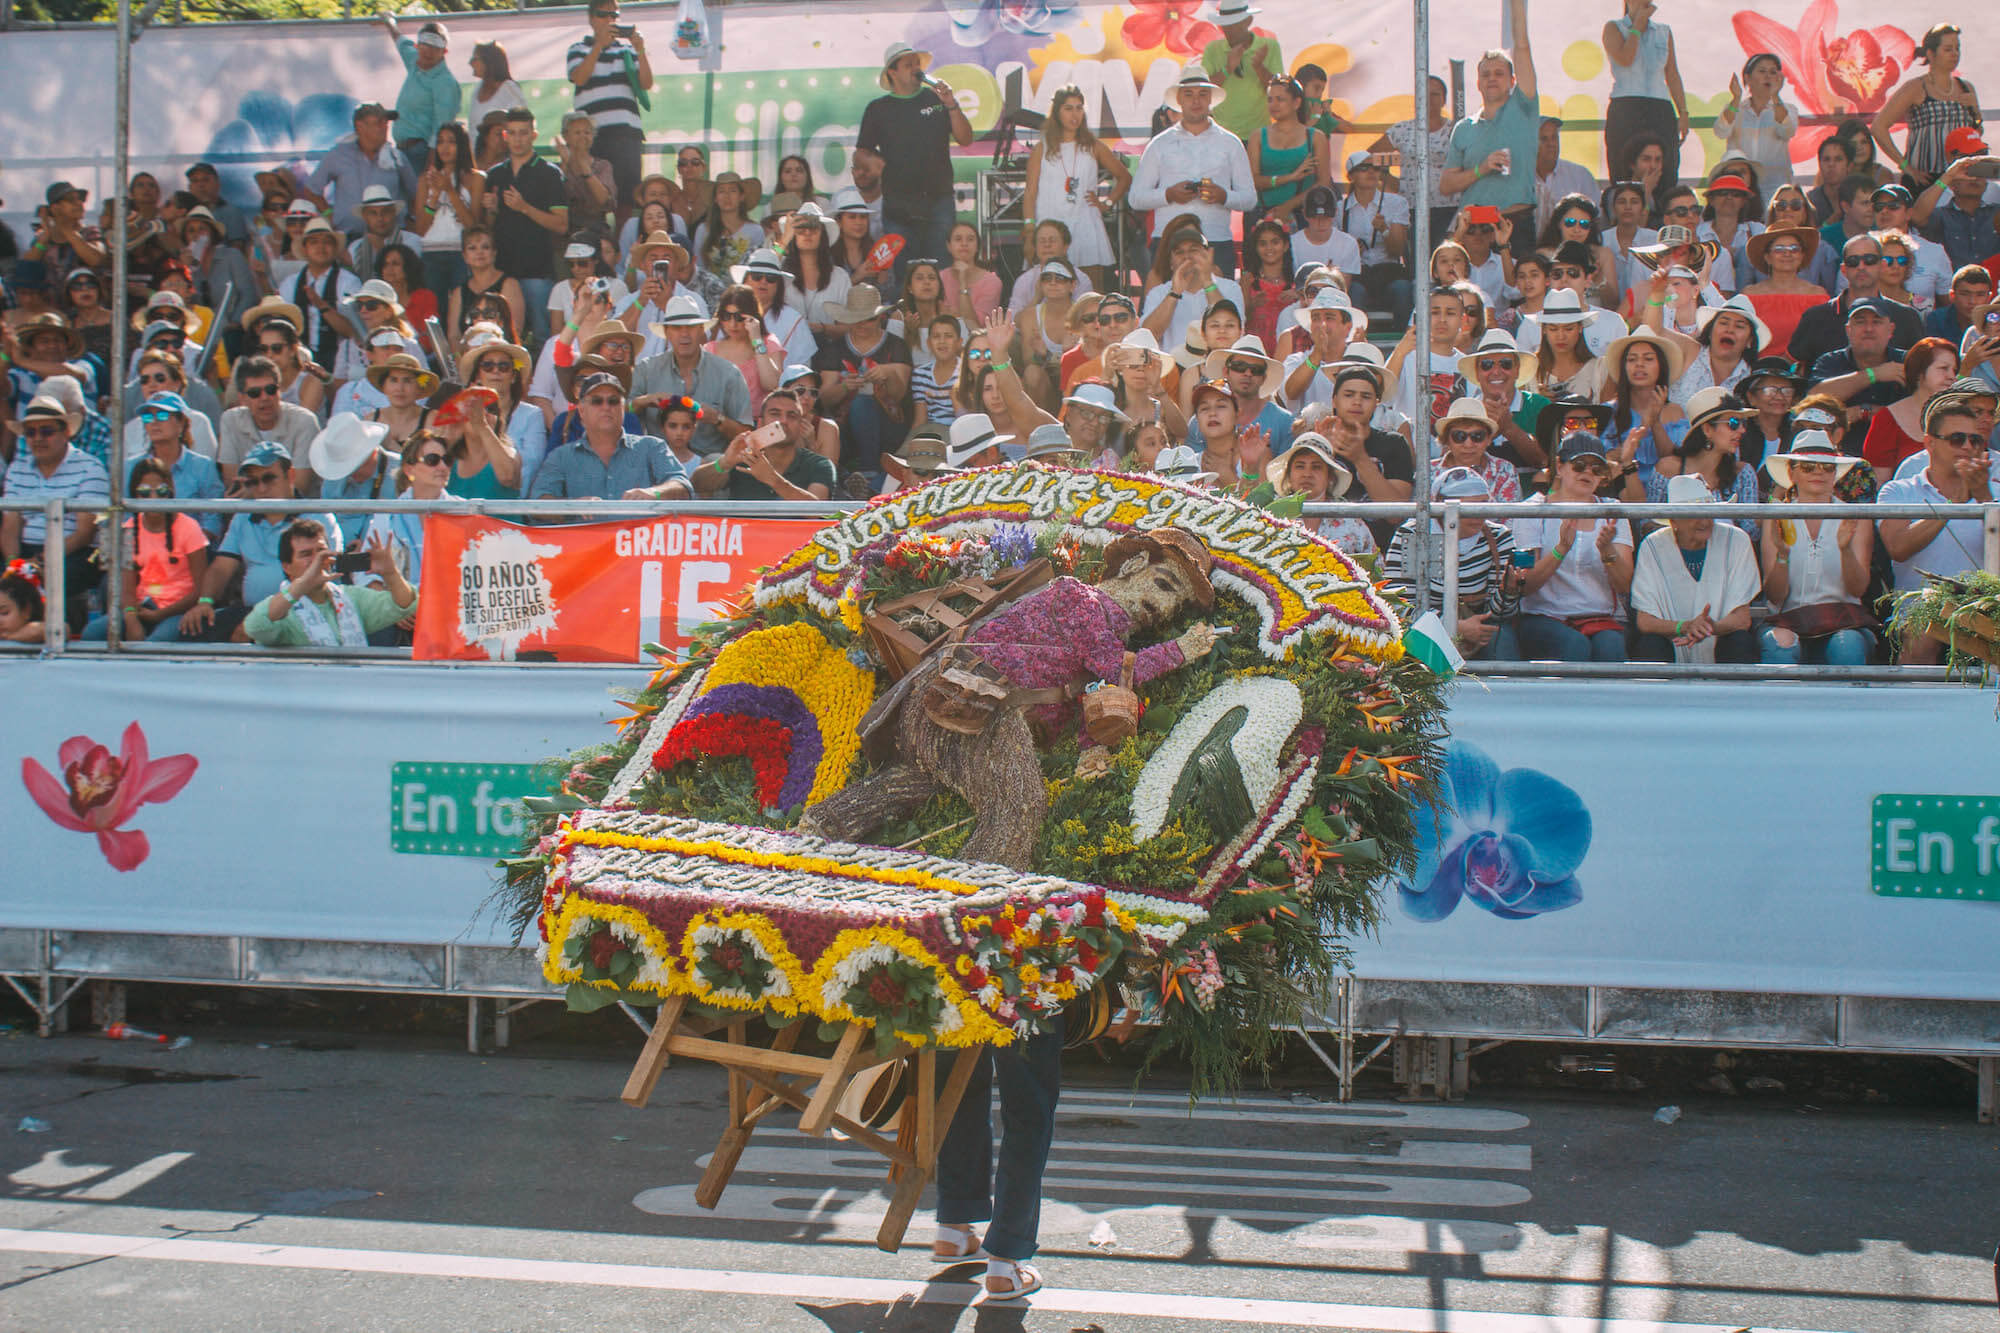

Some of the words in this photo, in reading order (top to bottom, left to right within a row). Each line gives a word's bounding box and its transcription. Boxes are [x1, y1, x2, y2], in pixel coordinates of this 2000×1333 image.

[615, 519, 743, 557] GRADERÍA
[463, 565, 483, 590] 60
[489, 561, 537, 588] AÑOS
[463, 592, 484, 609] DEL
[489, 588, 542, 608] DESFILE
[465, 609, 477, 624] DE
[480, 603, 546, 623] SILLETEROS
[402, 782, 458, 834] En
[1886, 818, 1954, 874] En
